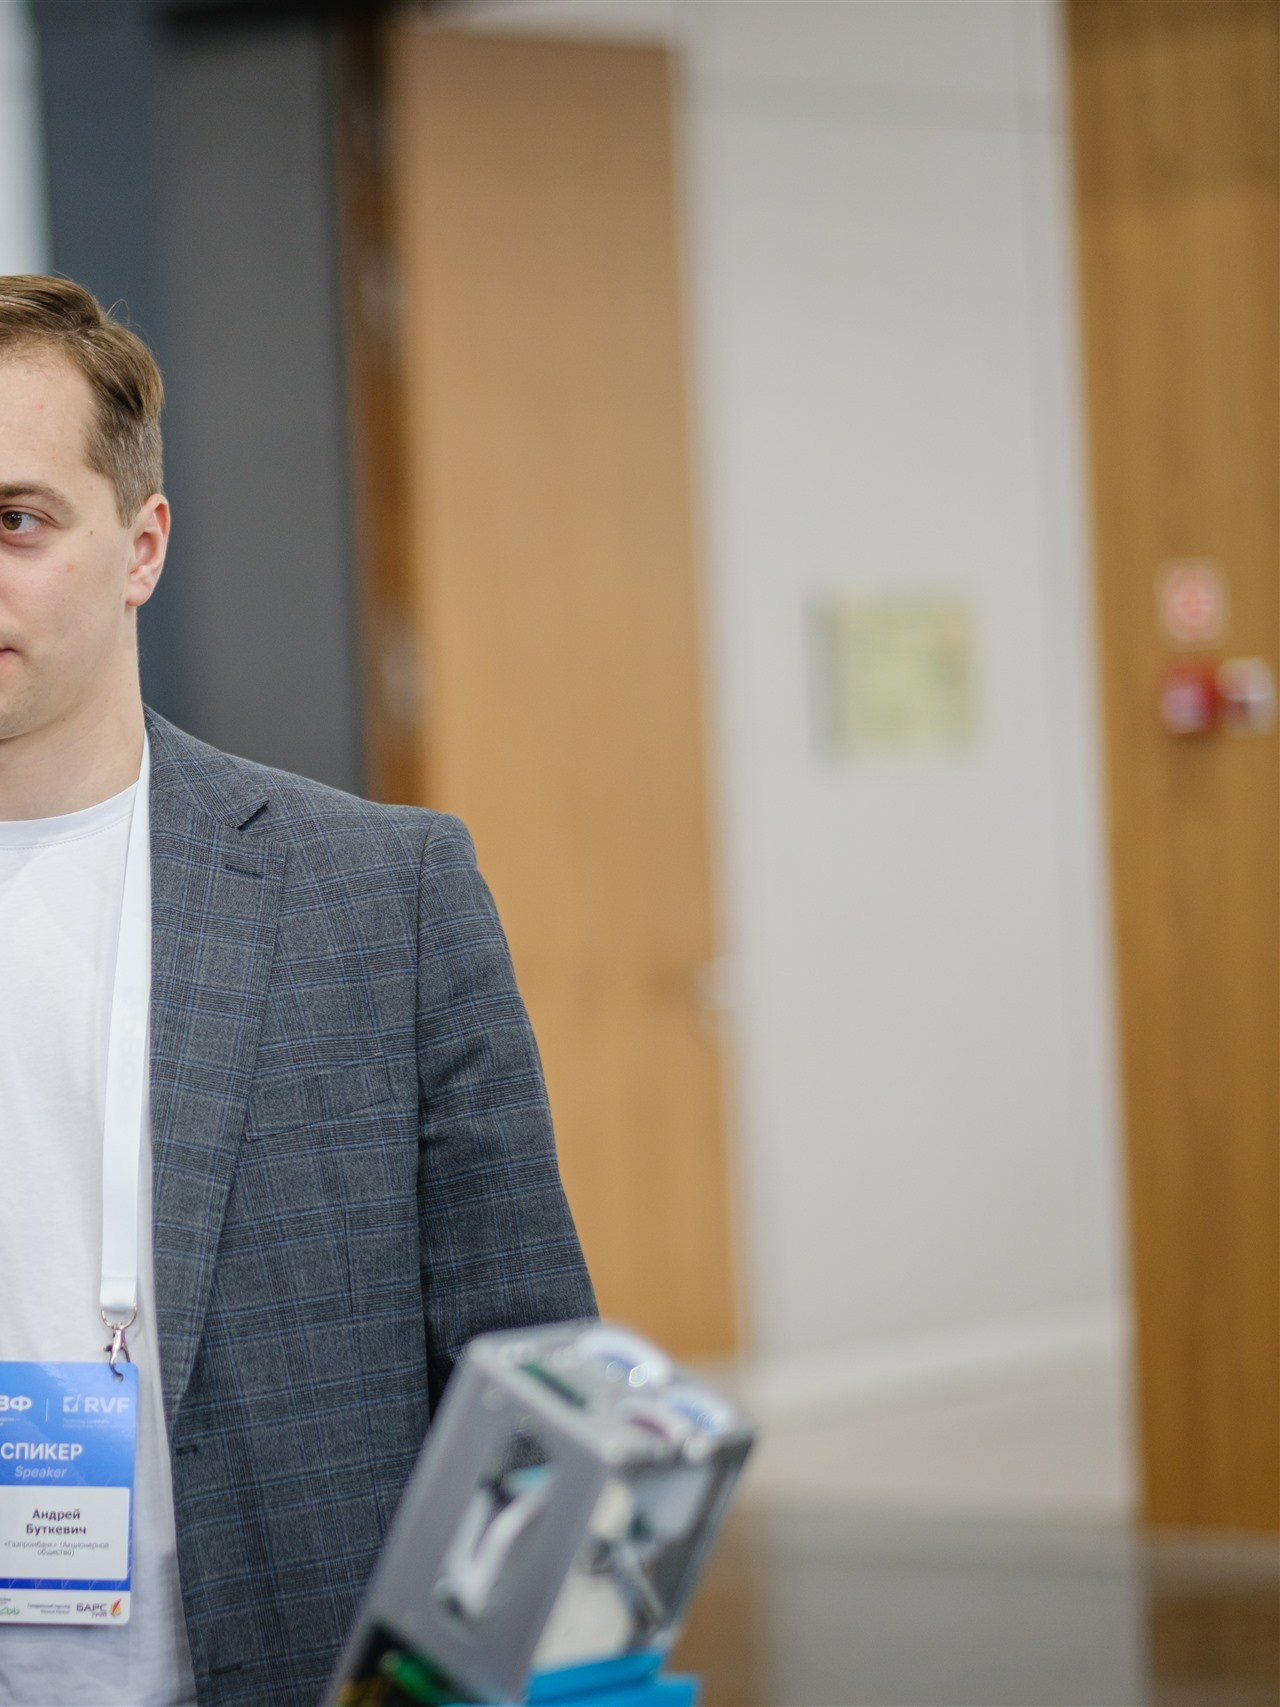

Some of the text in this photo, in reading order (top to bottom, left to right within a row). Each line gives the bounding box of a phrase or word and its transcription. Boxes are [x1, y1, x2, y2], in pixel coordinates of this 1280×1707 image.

[84, 1396, 130, 1413] RVF
[0, 1442, 83, 1461] СПИКЕР
[14, 1465, 67, 1478] Speaker
[32, 1509, 81, 1521] Андрей
[26, 1524, 87, 1535] Буткевич
[76, 1603, 107, 1612] БАРС
